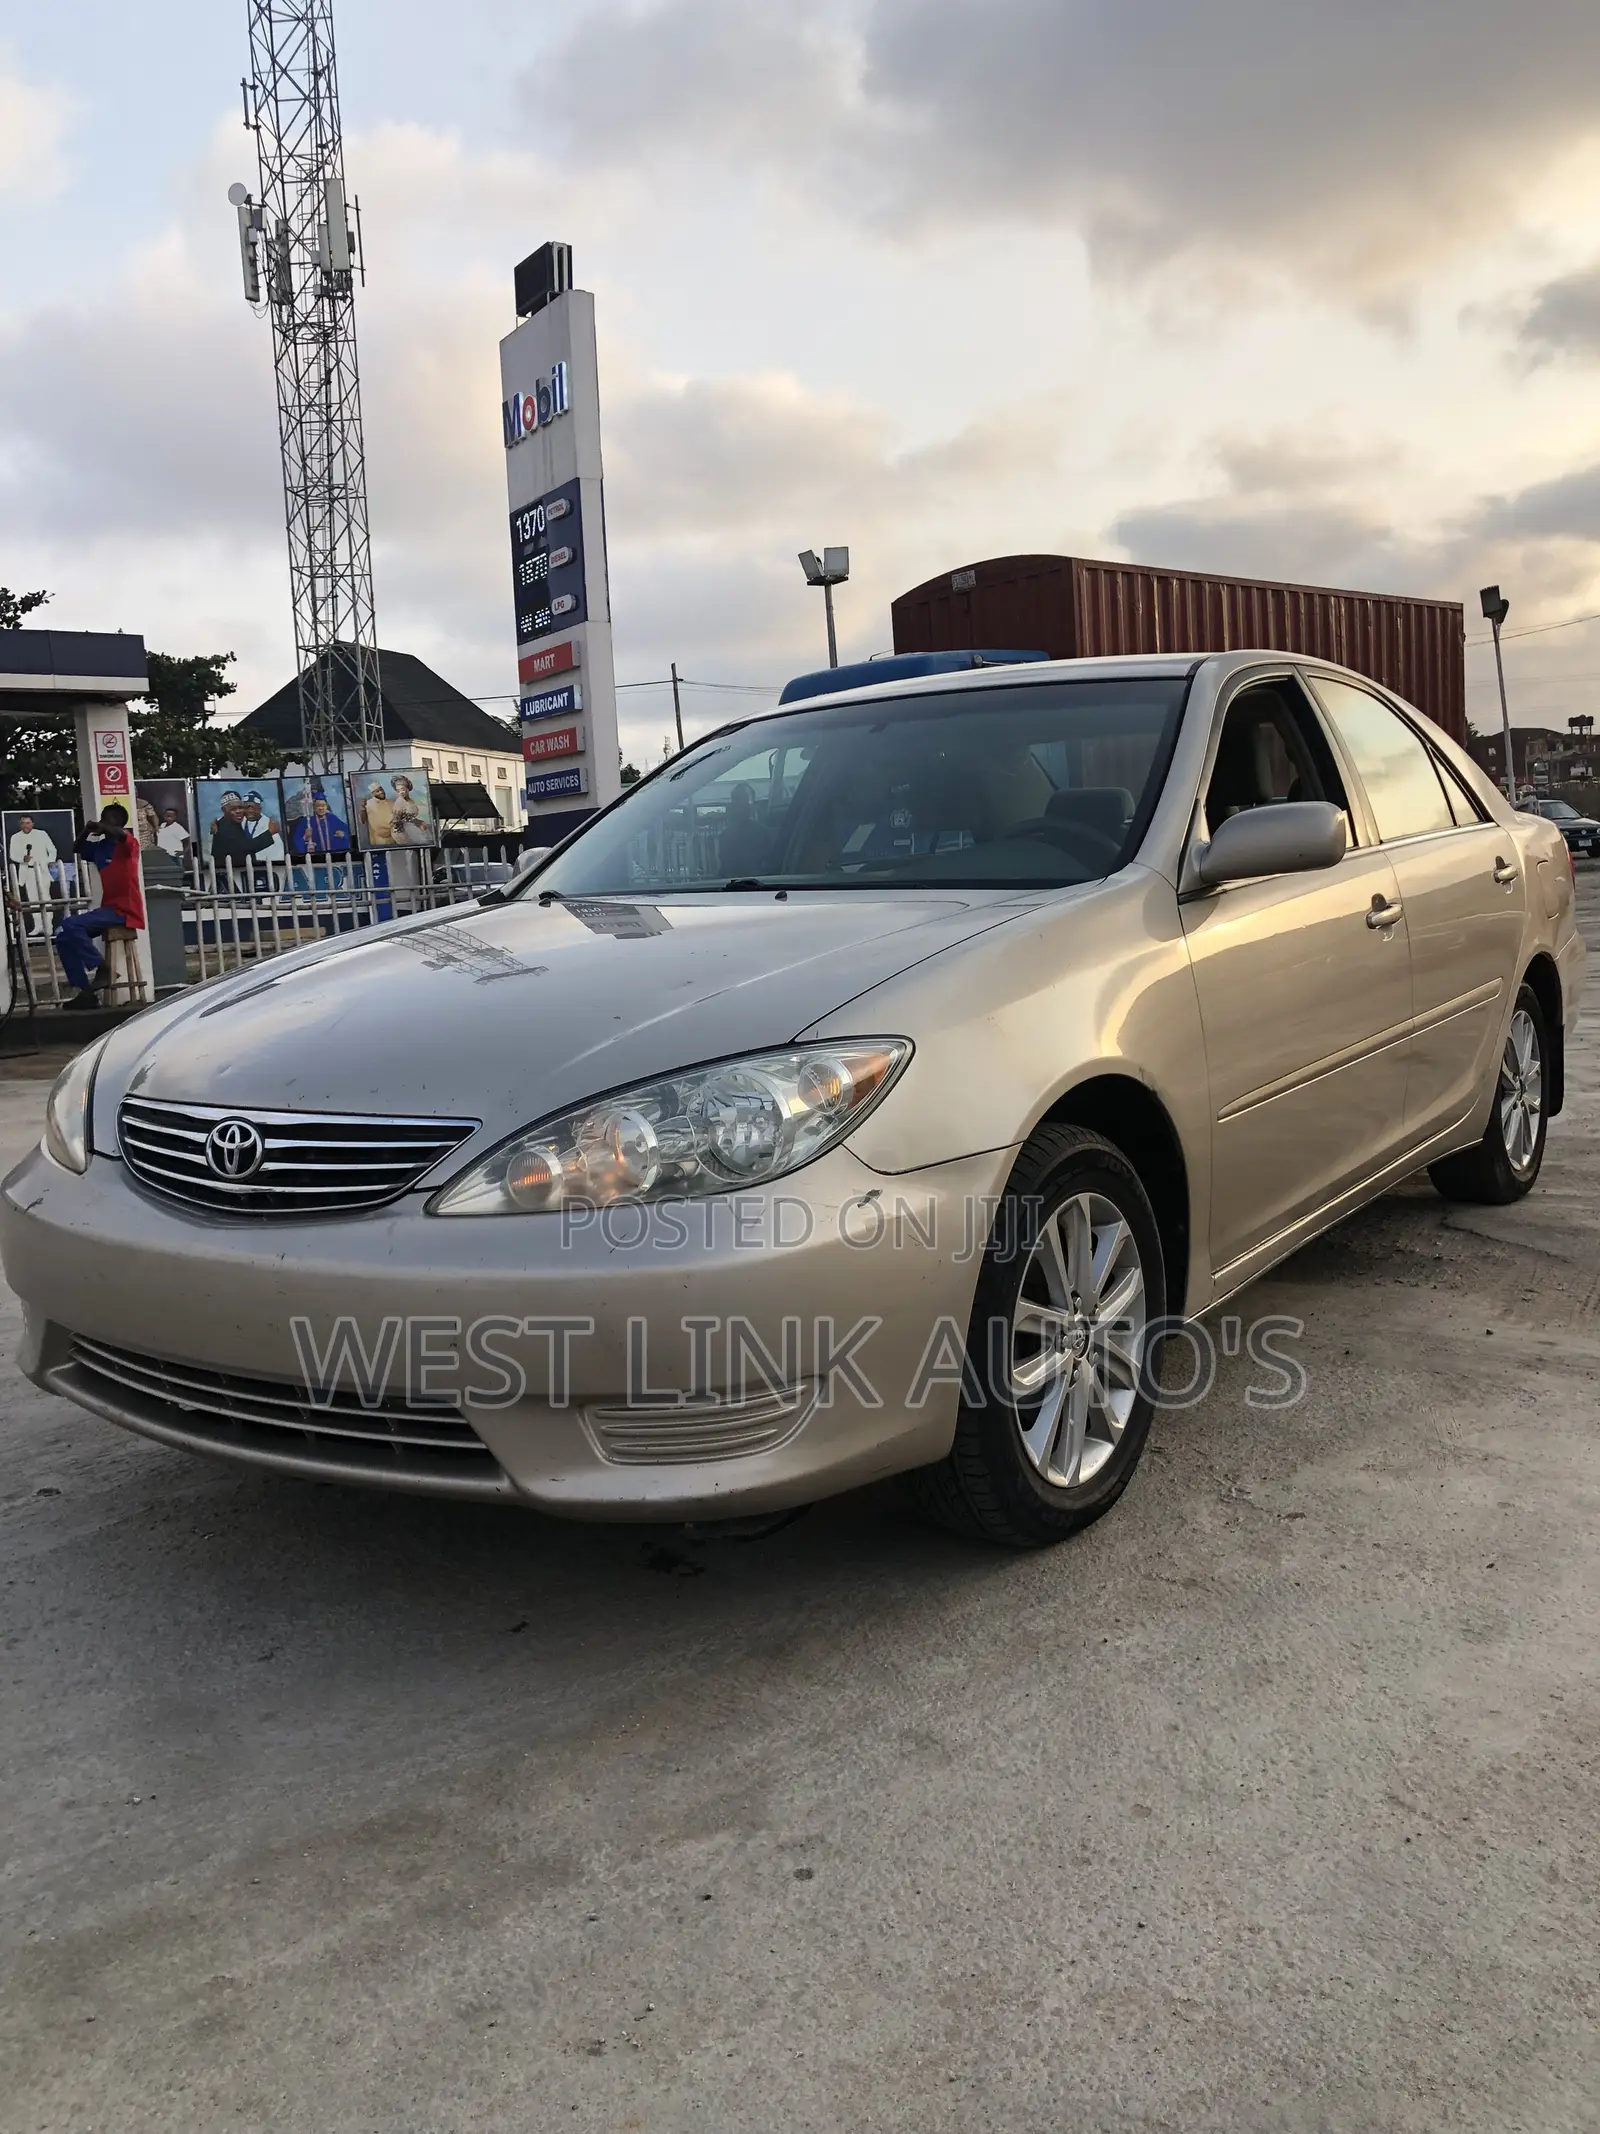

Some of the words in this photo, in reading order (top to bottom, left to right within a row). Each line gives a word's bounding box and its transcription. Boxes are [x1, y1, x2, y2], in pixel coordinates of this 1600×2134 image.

[502, 361, 568, 448] Mobil
[516, 505, 545, 542] 1370
[554, 600, 565, 611] LPG
[533, 654, 555, 673] MART
[525, 692, 569, 716] LUBRICANT
[529, 740, 546, 755] CAR
[547, 734, 570, 752] WASH
[527, 781, 545, 795] AUTO
[546, 774, 579, 791] SERVICES
